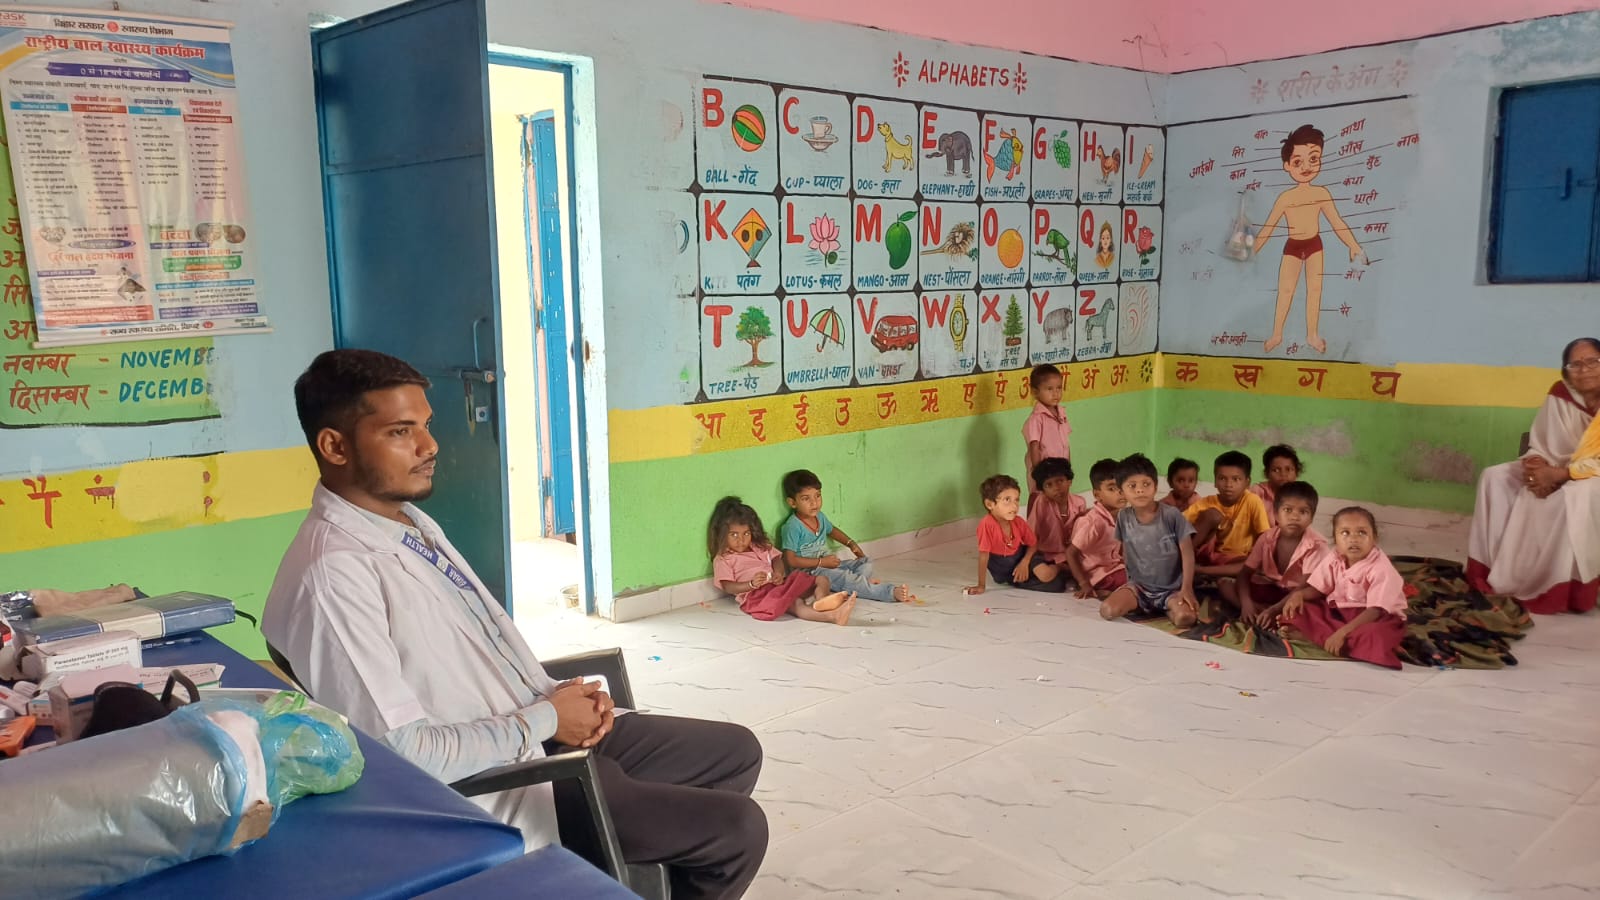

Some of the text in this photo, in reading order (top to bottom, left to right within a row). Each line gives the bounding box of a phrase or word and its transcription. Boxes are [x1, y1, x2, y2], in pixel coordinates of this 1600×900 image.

[78, 22, 105, 30] सरकार
[150, 25, 174, 36] विभाग
[24, 35, 206, 58] राष्ट्रीय बाल स्वास्थ्य कार्यक्रम
[918, 59, 1010, 88] ALPHABETS
[703, 88, 725, 128] B
[783, 97, 800, 134] C
[857, 105, 875, 142] D
[922, 112, 938, 149] E
[985, 120, 997, 152] F
[1034, 127, 1047, 160] G
[1083, 131, 1097, 162] H
[1129, 135, 1134, 164] I
[705, 169, 729, 183] BALL
[813, 175, 845, 190] प्याला
[704, 199, 728, 242] K
[786, 202, 804, 244] L
[855, 204, 882, 243] M
[922, 206, 942, 246] N
[983, 208, 998, 247] O
[1034, 209, 1050, 245] P
[1080, 209, 1094, 248] Q
[1124, 209, 1138, 243] R
[736, 271, 762, 290] पतंग
[819, 273, 843, 290] कमल
[889, 273, 910, 287] आम
[787, 299, 808, 338] U
[857, 297, 878, 334] V
[922, 294, 950, 328] W
[982, 294, 1001, 323] X
[1032, 290, 1049, 324] Y
[1079, 290, 1096, 316] Z
[704, 304, 733, 348] T
[1176, 362, 1402, 398] क ख ग घ
[749, 408, 767, 442] इ
[793, 394, 810, 435] ई
[835, 398, 852, 426] उ
[877, 392, 897, 419] ऊ
[963, 383, 977, 410] ए
[1082, 364, 1100, 389] अं
[1110, 364, 1130, 387] अः
[405, 536, 433, 560] HEALTH
